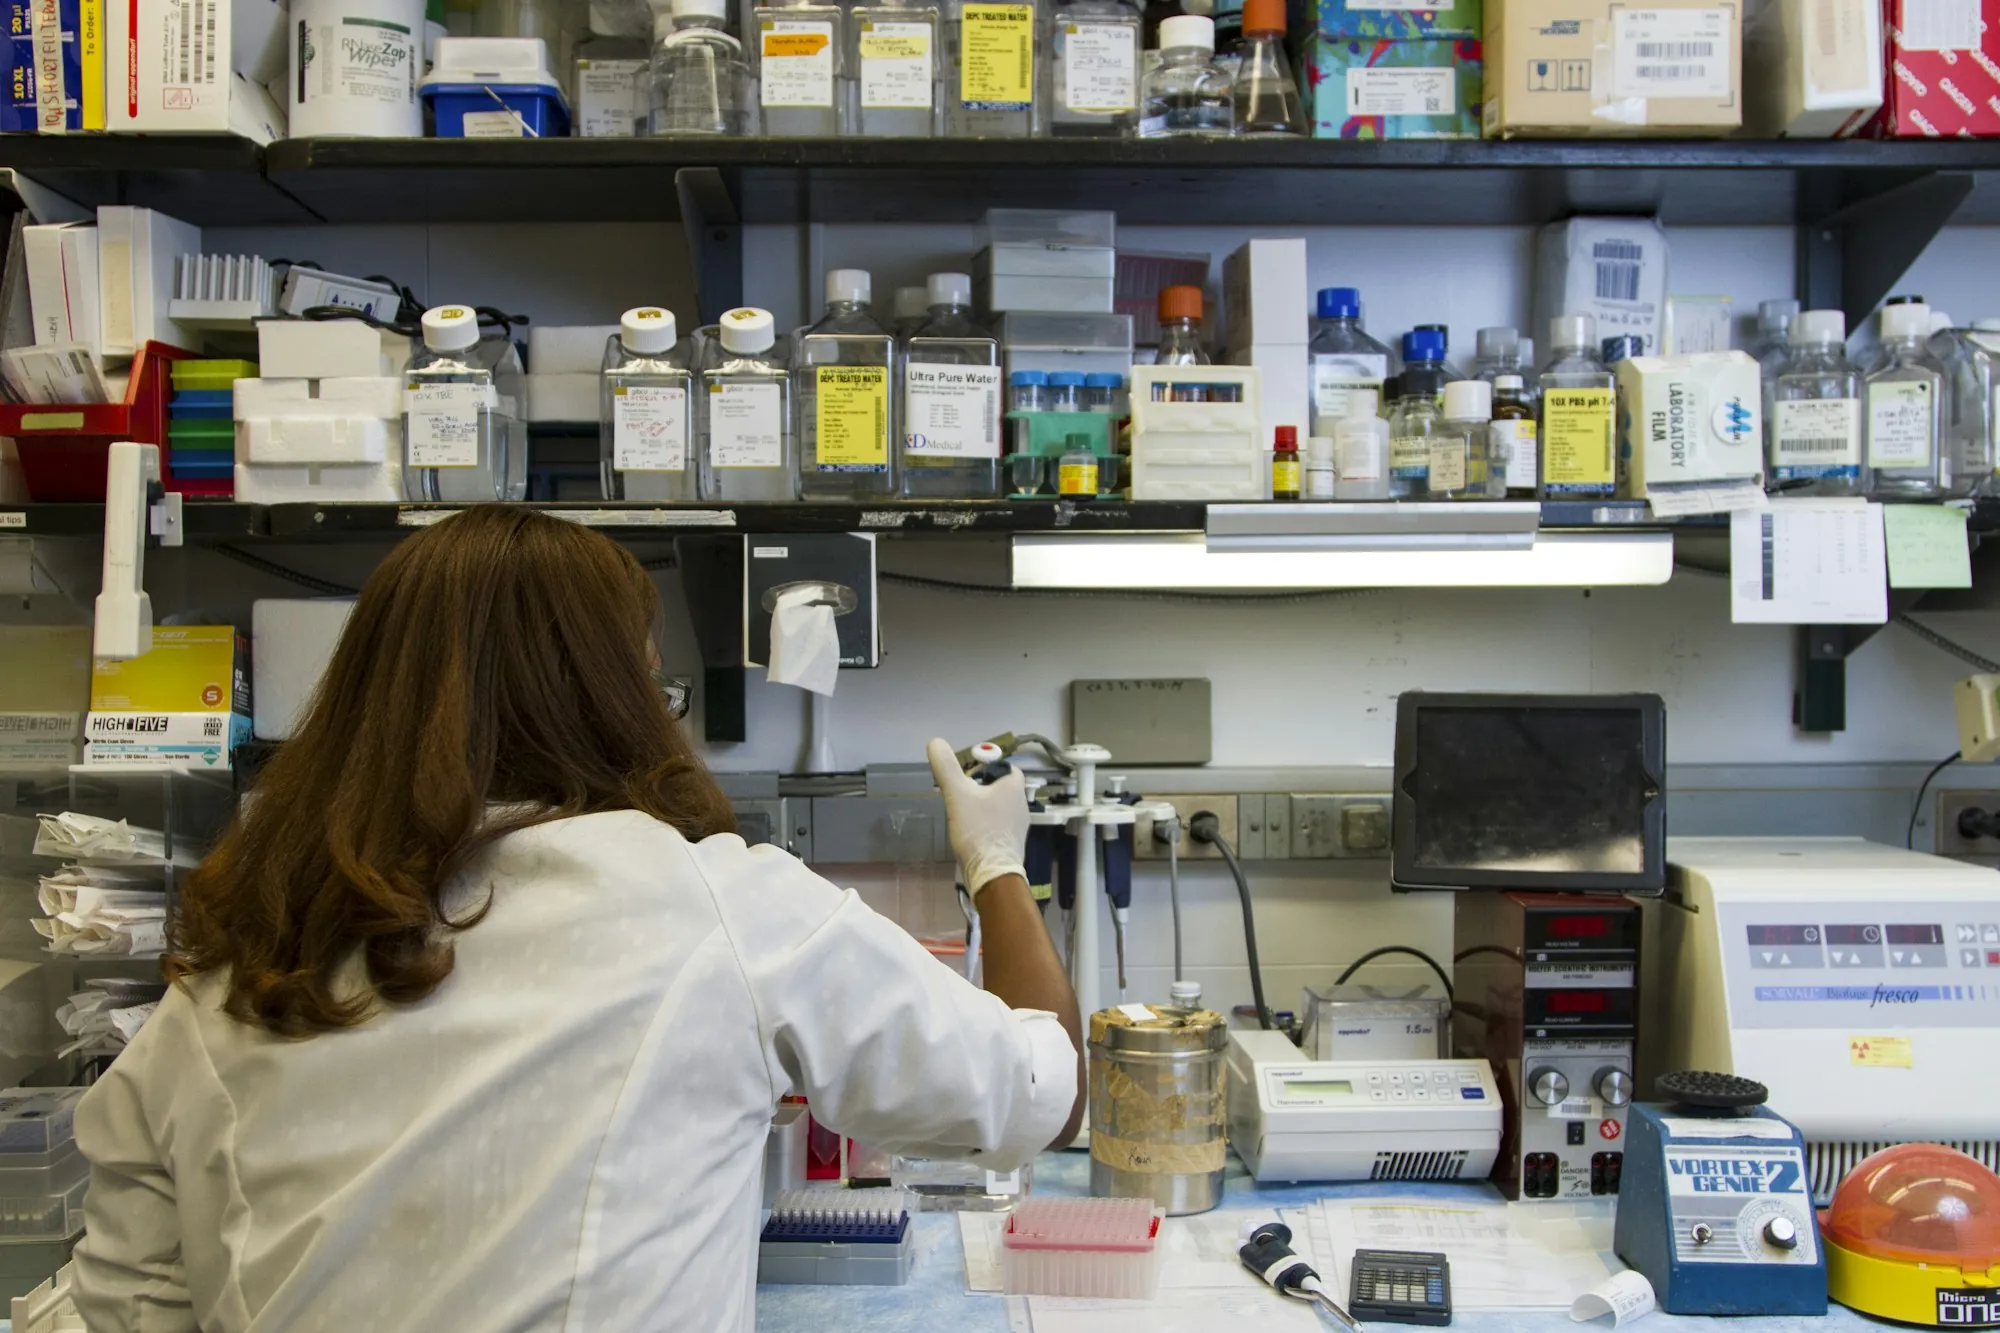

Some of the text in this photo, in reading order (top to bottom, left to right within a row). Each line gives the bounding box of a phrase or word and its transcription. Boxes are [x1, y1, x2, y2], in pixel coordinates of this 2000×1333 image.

[965, 12, 1028, 21] DEPC TREATED WATER
[11, 17, 22, 33] 20
[86, 7, 95, 55] To Order:
[341, 37, 407, 63] RNaseZap
[349, 47, 397, 68] Wipes
[129, 37, 137, 104] original eppendorf
[13, 66, 24, 99] 10 XL
[820, 375, 882, 383] DEPC TREATED WATER
[910, 370, 998, 383] Ultra Pure Water
[1550, 396, 1566, 406] 10X
[1569, 396, 1586, 406] PBS
[1588, 398, 1600, 408] pH
[1651, 411, 1667, 442] FILM
[1668, 382, 1686, 469] LABORATORY
[926, 439, 963, 450] Medical
[6, 516, 22, 525] tips
[206, 690, 218, 701] S
[93, 716, 169, 732] HIGH FIVE
[204, 728, 221, 736] FREE
[1826, 987, 1868, 999] Biofuge
[1870, 982, 1920, 1008] fresco
[1405, 1024, 1422, 1034] 1.5
[1692, 1160, 1805, 1194] GENIE 2
[1939, 1292, 1986, 1303] Micro
